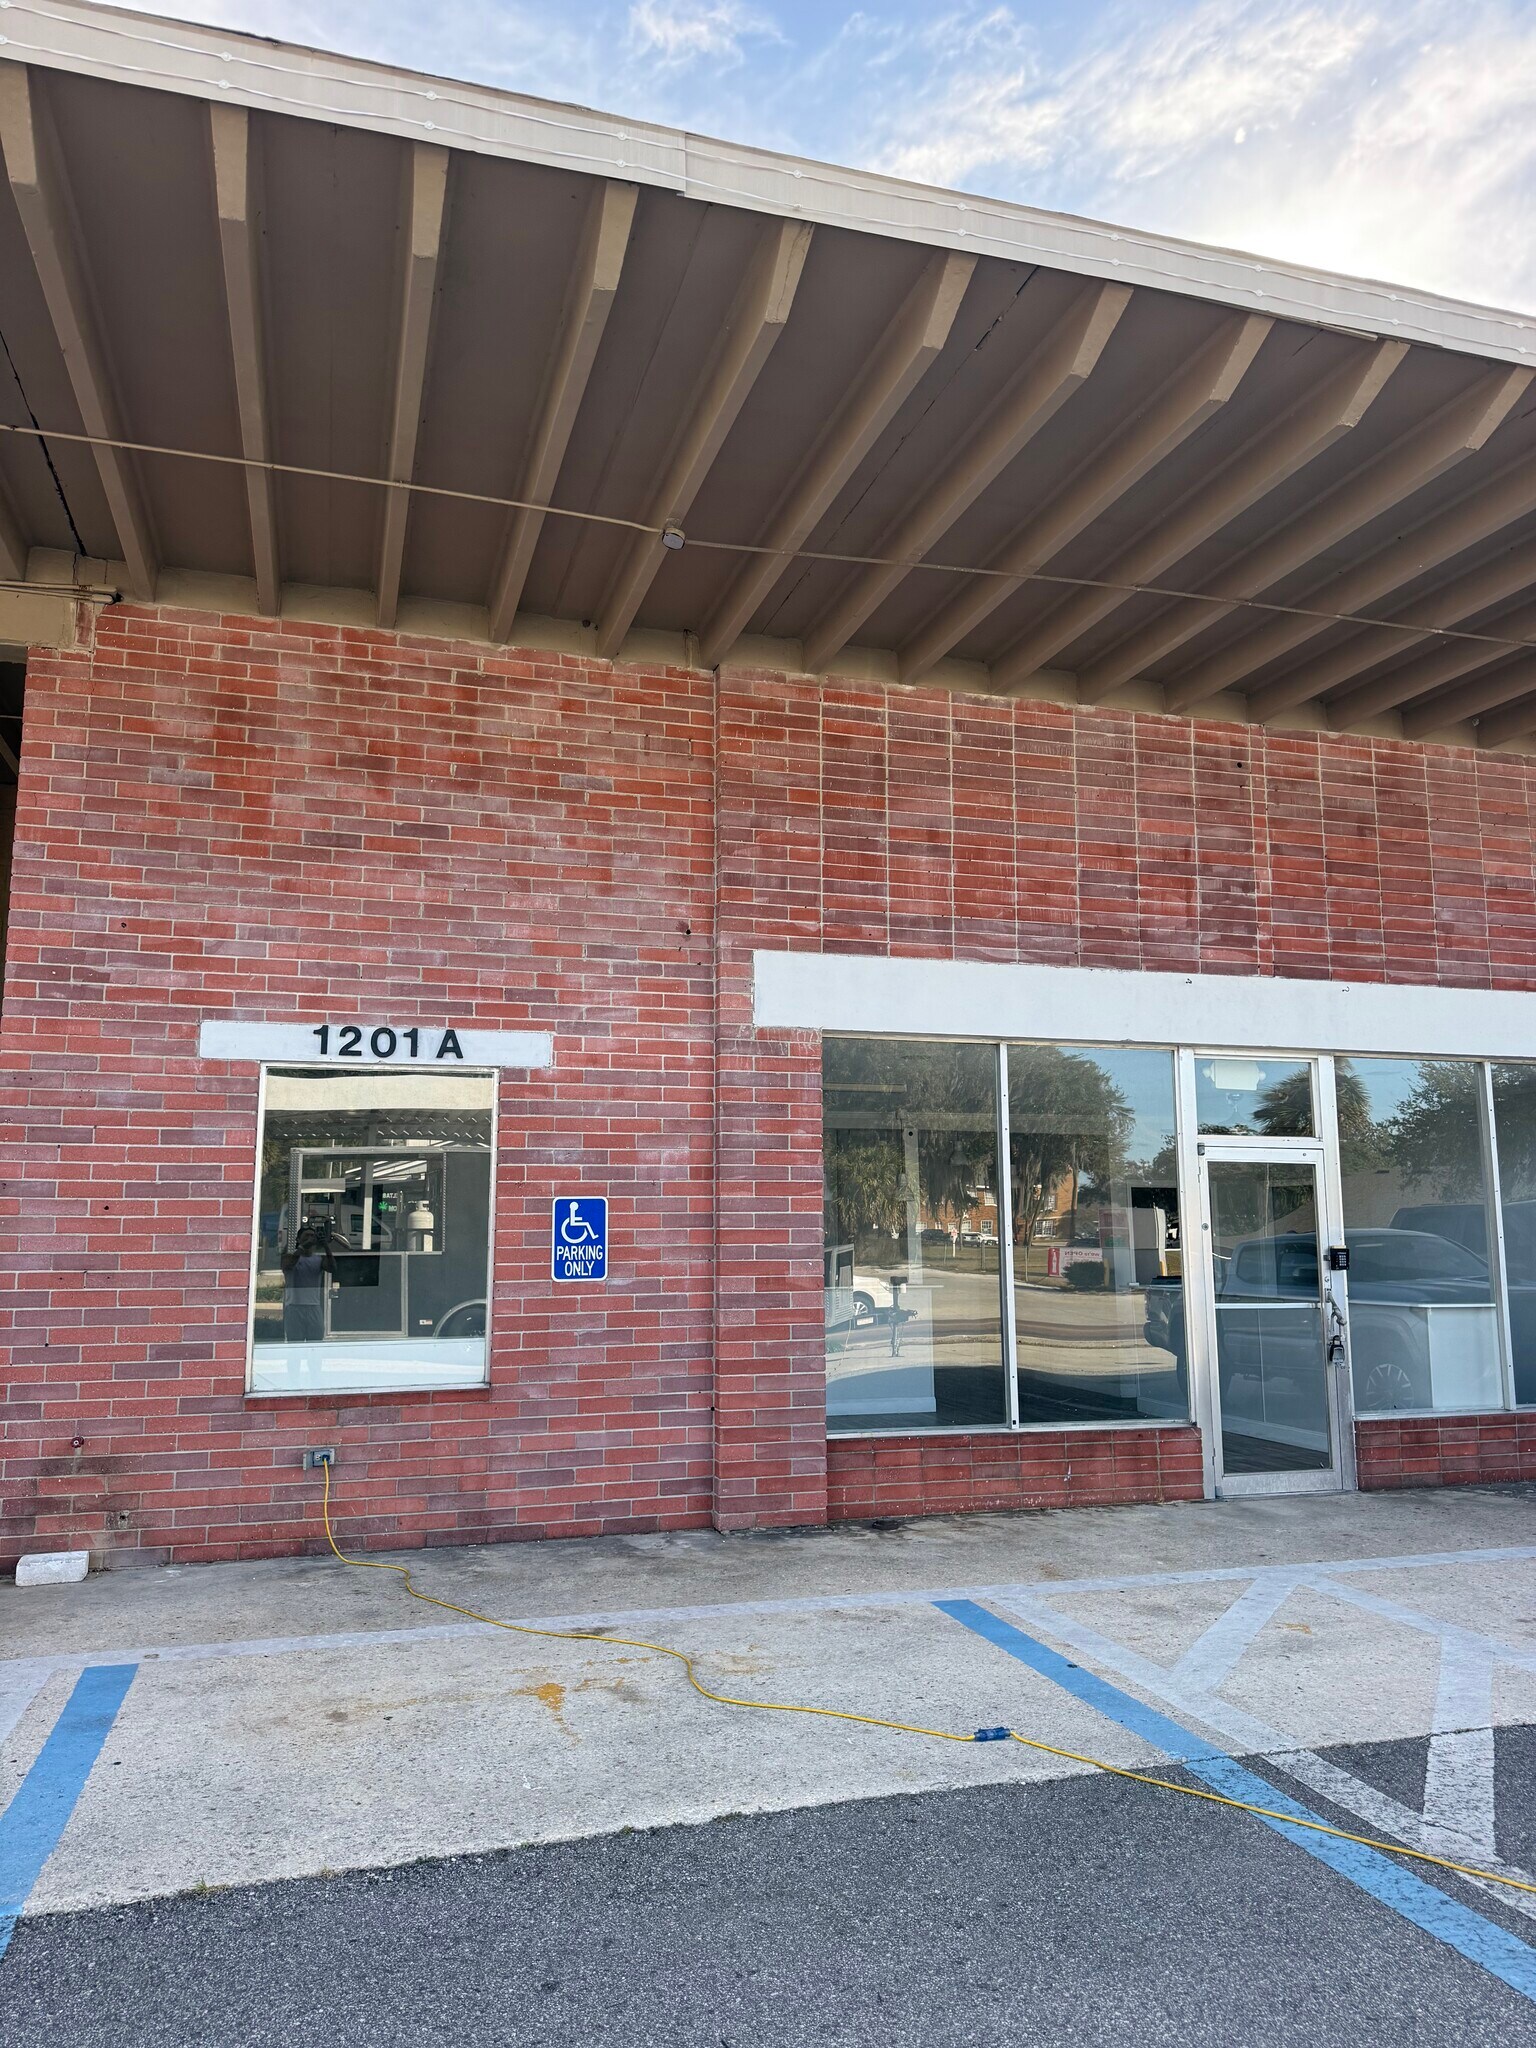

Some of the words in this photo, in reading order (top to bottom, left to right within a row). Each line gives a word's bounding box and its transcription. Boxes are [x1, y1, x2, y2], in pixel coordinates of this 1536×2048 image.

[313, 1024, 418, 1058] 1201
[436, 1028, 463, 1058] A
[556, 1245, 603, 1261] PARKING
[564, 1261, 595, 1276] ONLY
